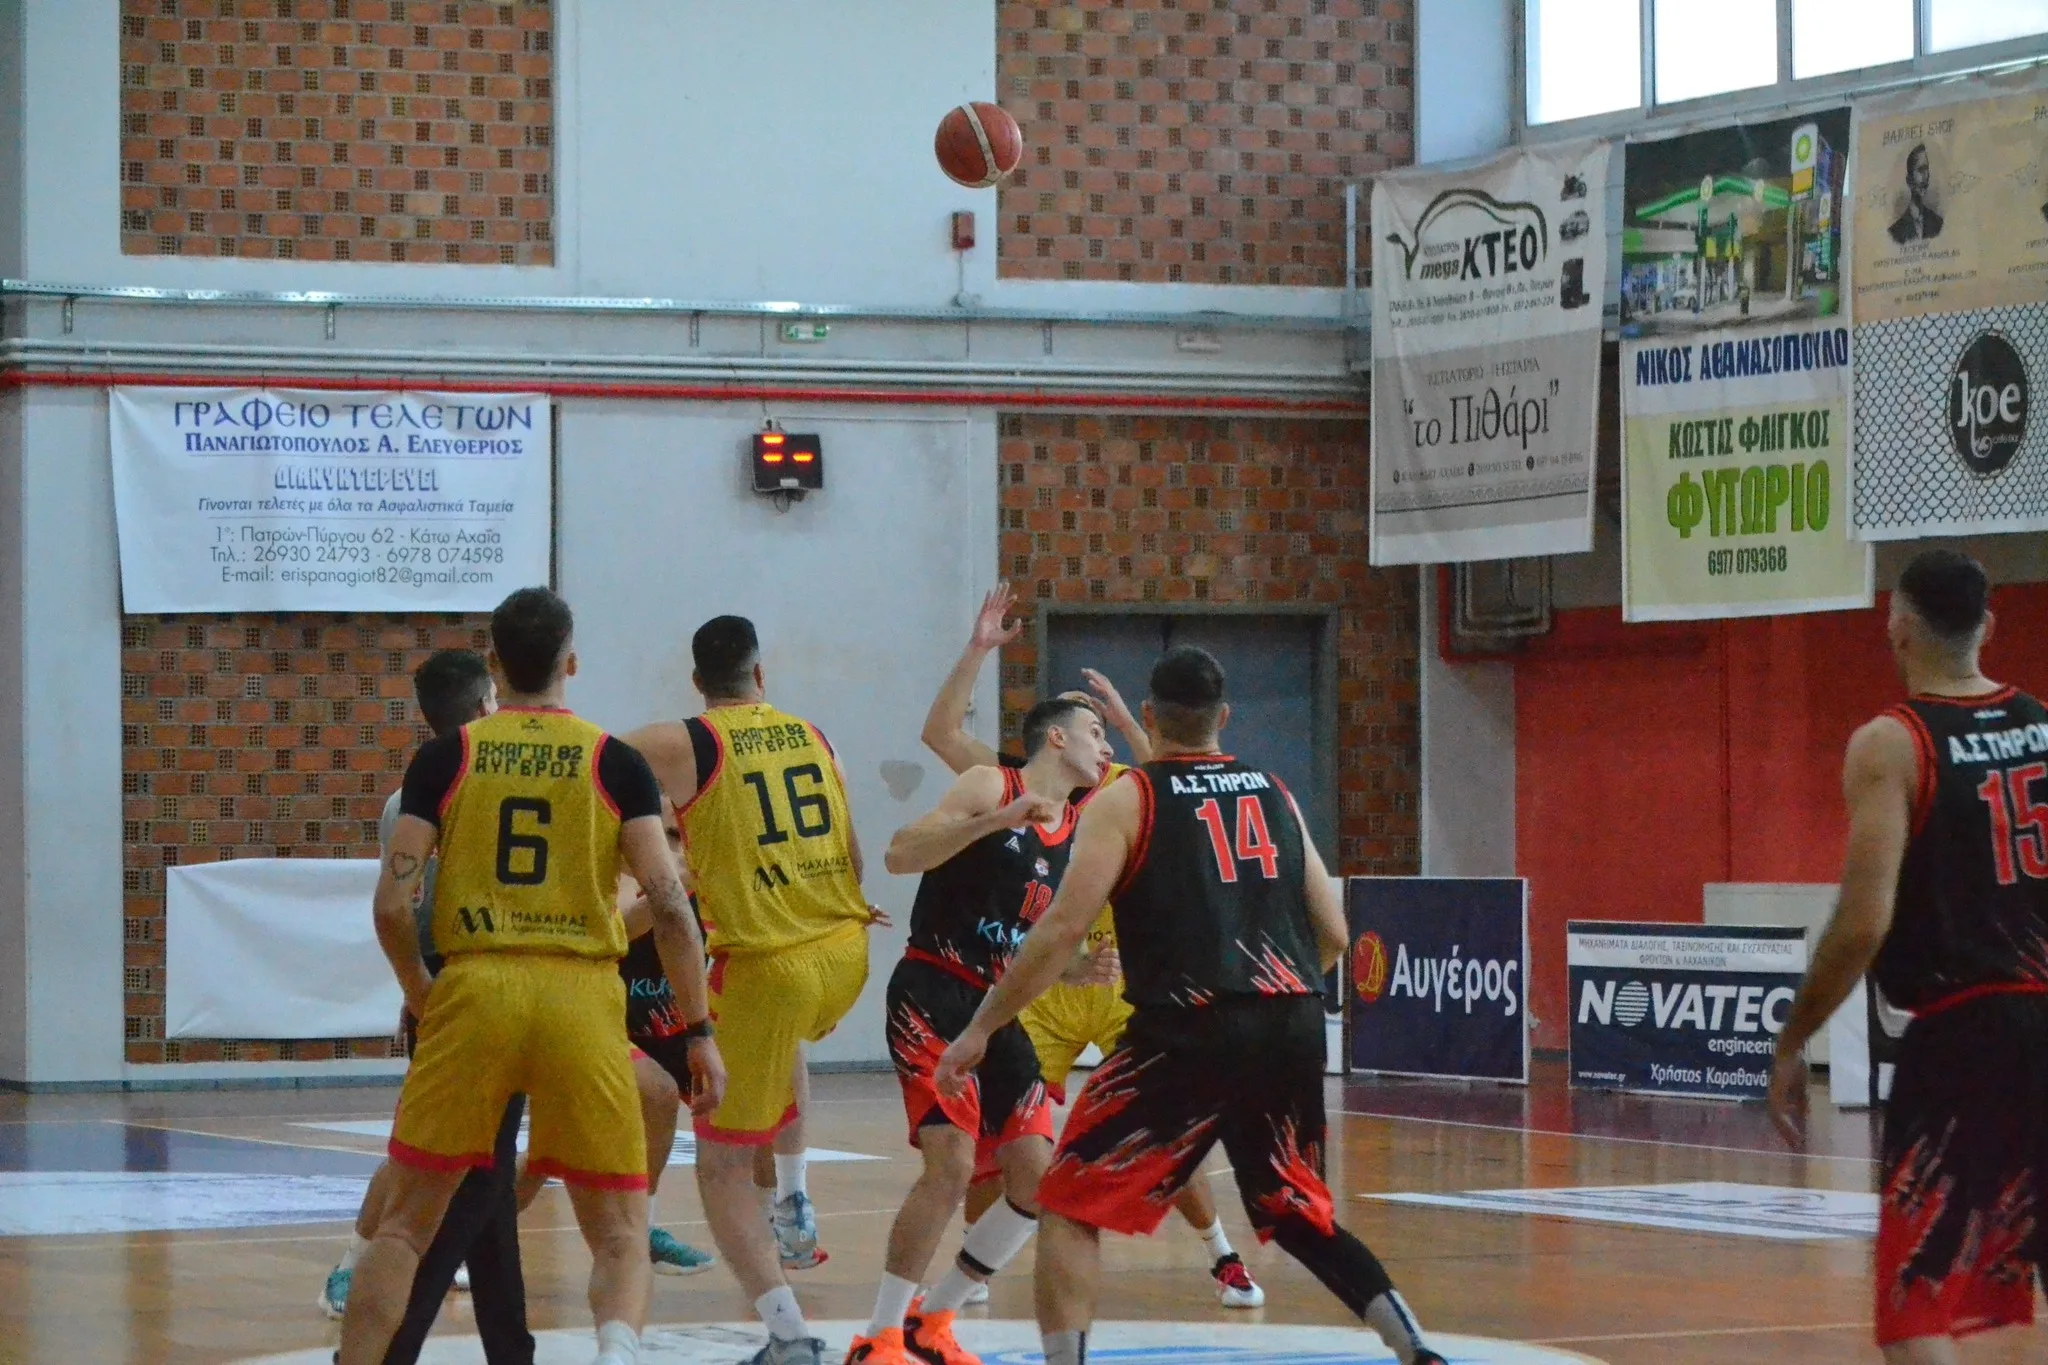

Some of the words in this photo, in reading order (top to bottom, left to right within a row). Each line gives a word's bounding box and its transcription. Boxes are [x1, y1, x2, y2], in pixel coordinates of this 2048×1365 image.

[1636, 346, 1692, 387] ΝΙΚΟΣ
[1700, 327, 1849, 381] ΑΘΑΝΑΣΟΠΟΥΛΟ
[174, 398, 331, 431] ΓΡΑΦΕΙΟ
[342, 402, 532, 431] ΤΕΛΕΤΩΝ
[1955, 370, 2022, 432] koe
[185, 432, 370, 454] ΠΑΝΑΓΙΩΤΟΠΟΥΛΟΣ
[377, 434, 399, 454] Α.
[407, 434, 524, 455] ΕΛΕΥΘΕΡΙΟΣ
[1738, 408, 1831, 454] ΦΛΙΓΚΟΣ
[198, 498, 253, 512] Γίνονται
[257, 496, 305, 513] τελετές
[308, 501, 324, 514] με
[327, 498, 353, 513] όλα
[356, 501, 374, 513] τα
[377, 499, 464, 515] Ασφαλιστικά
[468, 499, 514, 516] Ταμεία
[1666, 459, 1831, 539] ΦΥΤΩΡΙΟ
[254, 545, 311, 563] 26930
[316, 546, 370, 563] 24793
[386, 547, 432, 564] 6978
[437, 547, 504, 564] 074598
[371, 527, 395, 544] 62
[410, 527, 451, 544] Κάτω
[222, 566, 275, 583] E-mail:
[281, 567, 494, 588] erispanagiot82@gmail.com
[1708, 548, 1734, 576] 6977
[1736, 545, 1788, 575] 079368
[733, 734, 812, 756] ΑΥΓΕΡΟΣ
[742, 762, 832, 846] 16
[1977, 761, 2048, 885] 15
[496, 796, 552, 886] 6
[1195, 794, 1279, 883] 14
[1389, 943, 1518, 1017] Αυγέρος
[1578, 979, 1796, 1034] NOVATEC
[1708, 1036, 1776, 1057] engineeri
[1650, 1063, 1702, 1087] Χρήστος
[1706, 1066, 1771, 1090] Καραθανά
